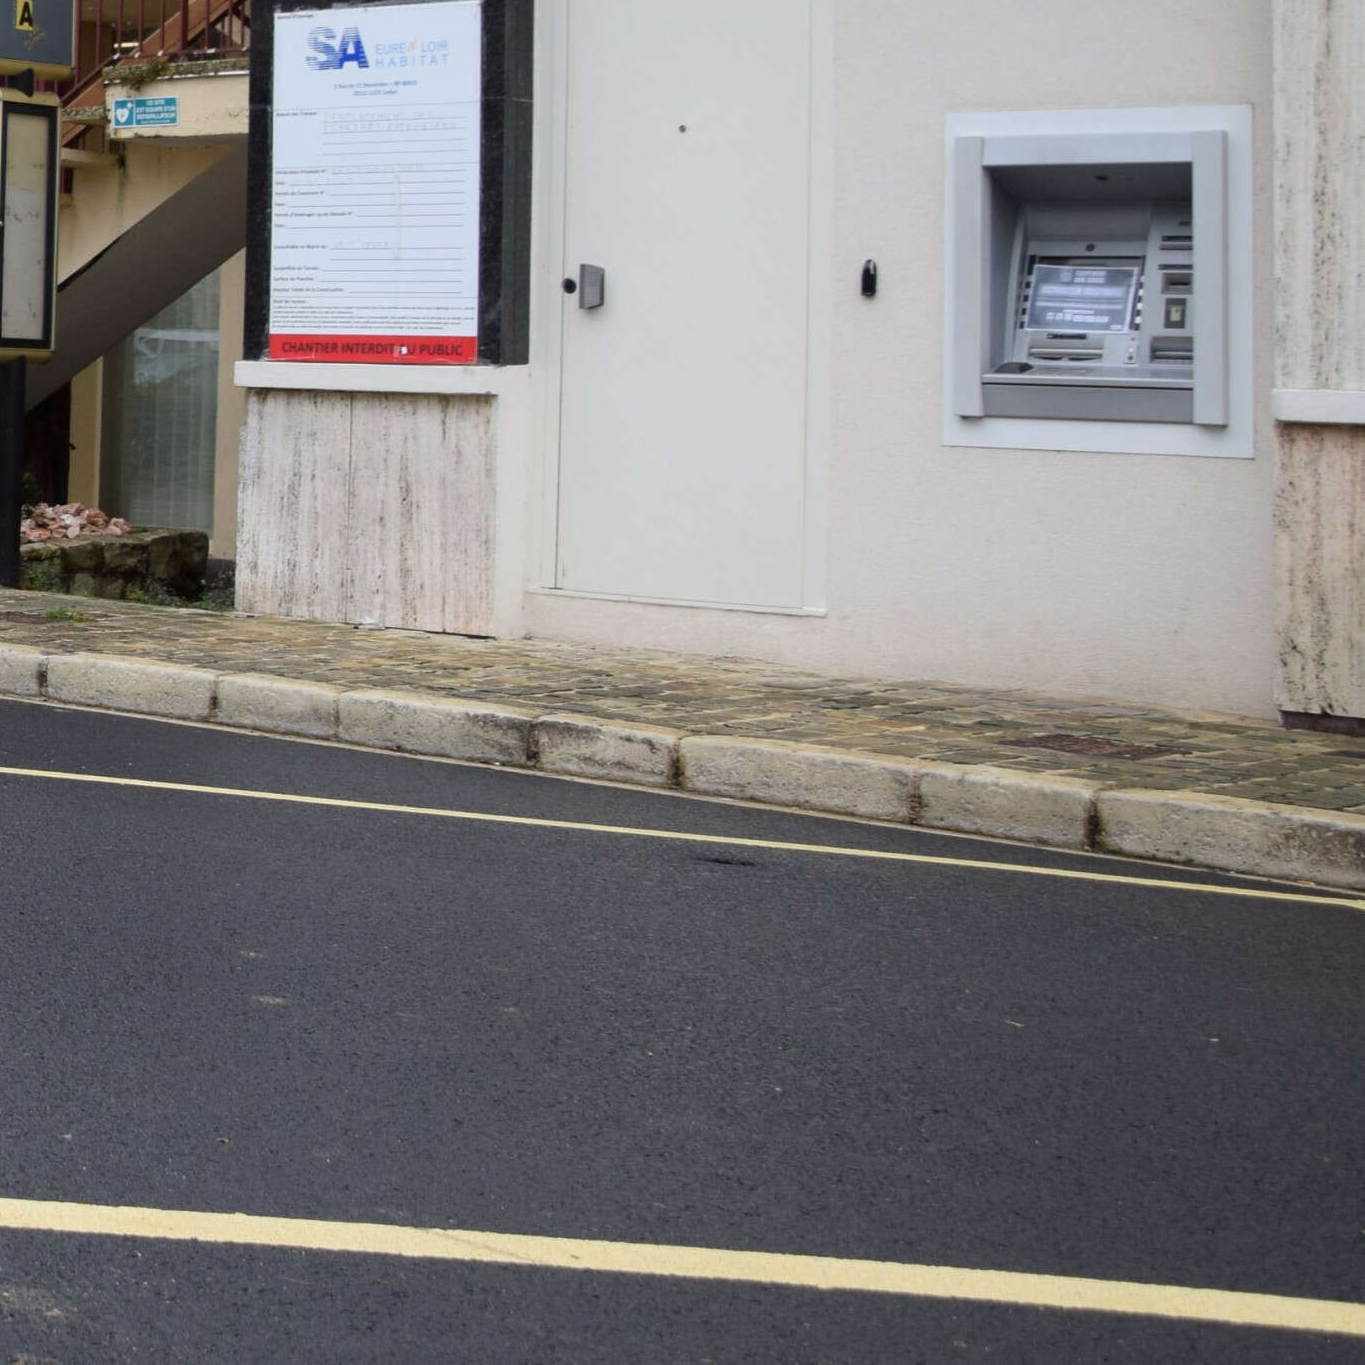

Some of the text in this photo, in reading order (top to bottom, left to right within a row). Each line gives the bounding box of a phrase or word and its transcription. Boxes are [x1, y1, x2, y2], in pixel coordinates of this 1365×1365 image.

[305, 26, 370, 71] SA
[375, 42, 407, 55] EURE
[421, 40, 449, 53] LOIR
[375, 54, 449, 68] HABITAT
[281, 341, 339, 353] CHANTIER
[341, 343, 394, 355] INTERDIT
[419, 344, 463, 356] PUBLIC
